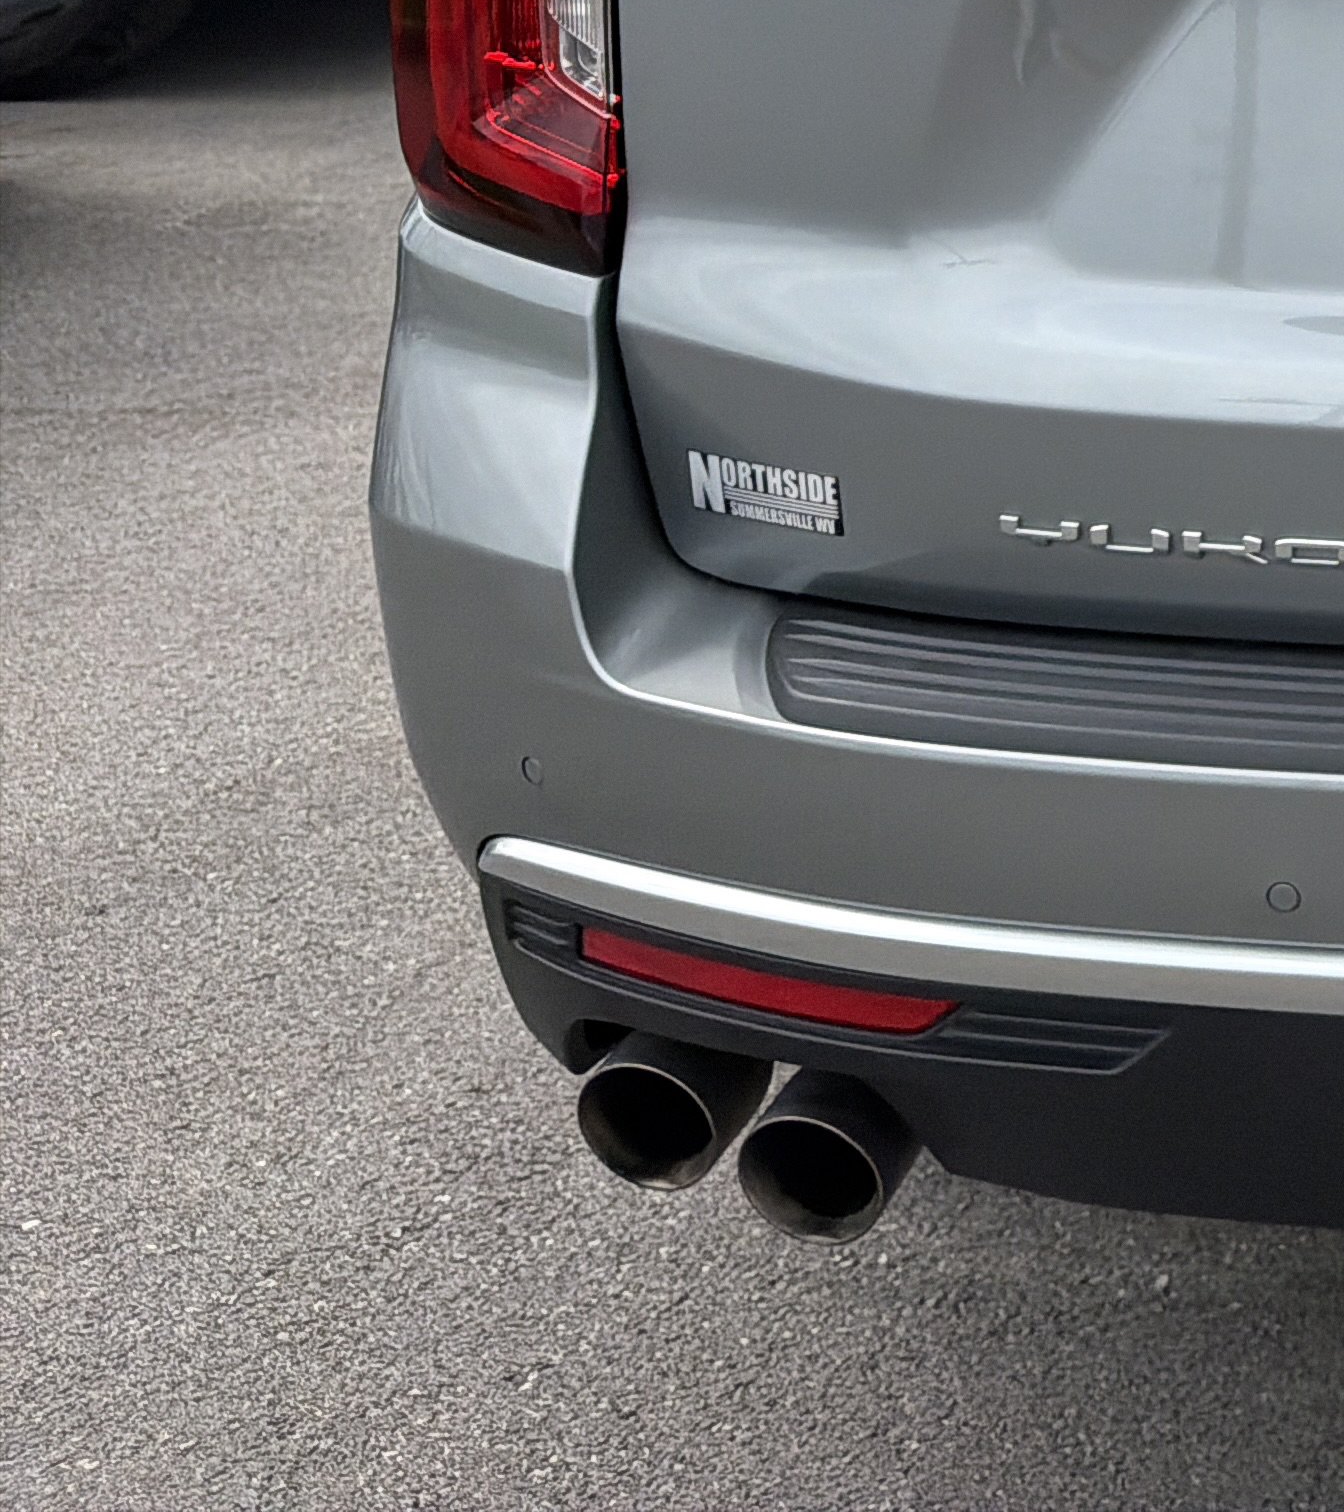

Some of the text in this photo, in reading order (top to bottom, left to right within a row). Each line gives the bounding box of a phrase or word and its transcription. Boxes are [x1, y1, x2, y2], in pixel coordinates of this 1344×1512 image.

[688, 449, 839, 514] NORTHSIDE
[730, 501, 835, 535] SUMMERSVILLE WV
